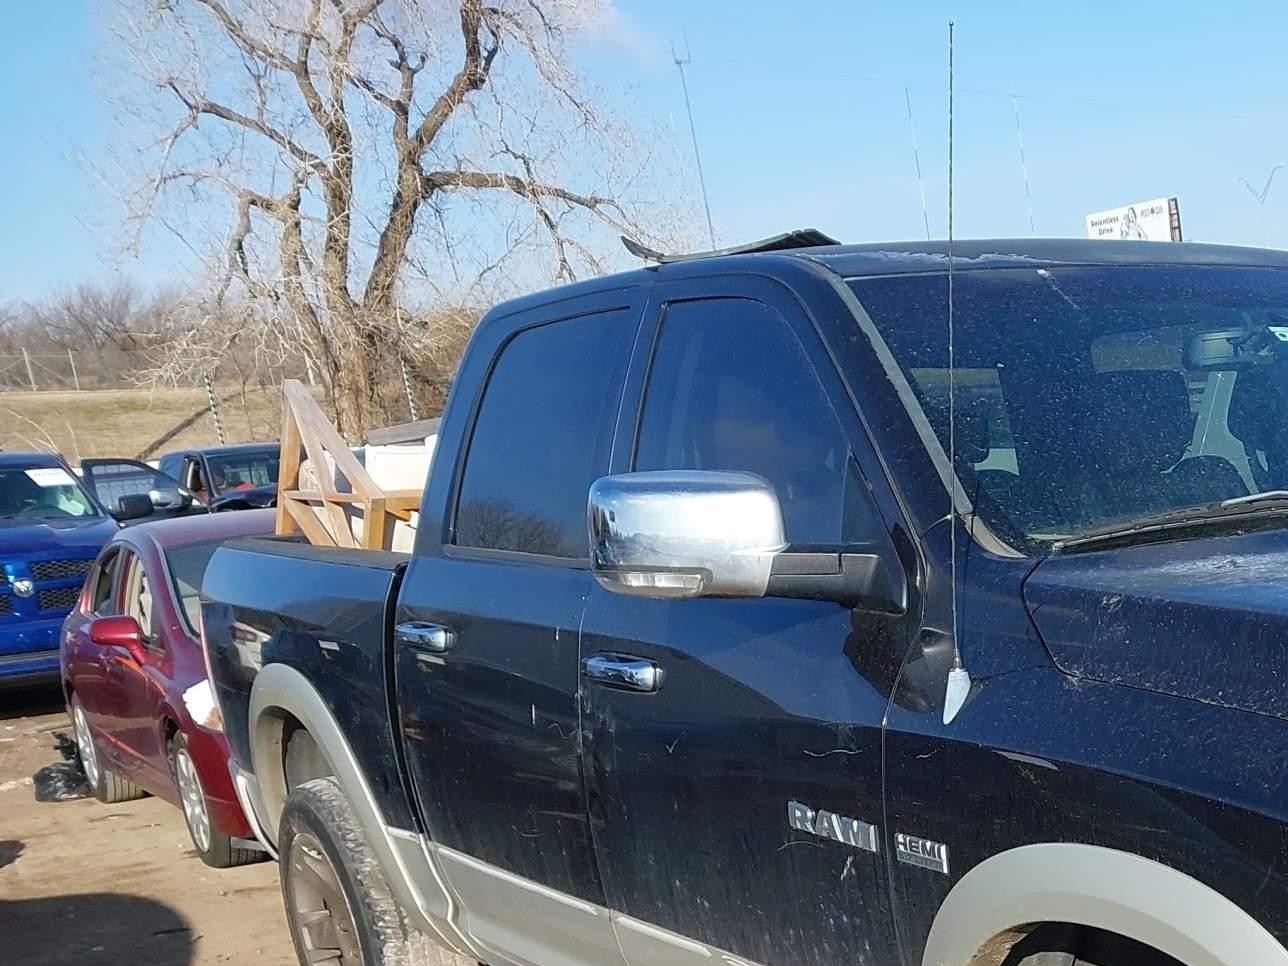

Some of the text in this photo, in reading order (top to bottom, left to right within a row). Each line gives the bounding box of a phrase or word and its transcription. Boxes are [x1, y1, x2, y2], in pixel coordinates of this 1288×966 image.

[1090, 215, 1120, 227] Relentless
[1098, 227, 1114, 236] Drive
[787, 800, 880, 853] RAM
[893, 832, 951, 875] HEMI
